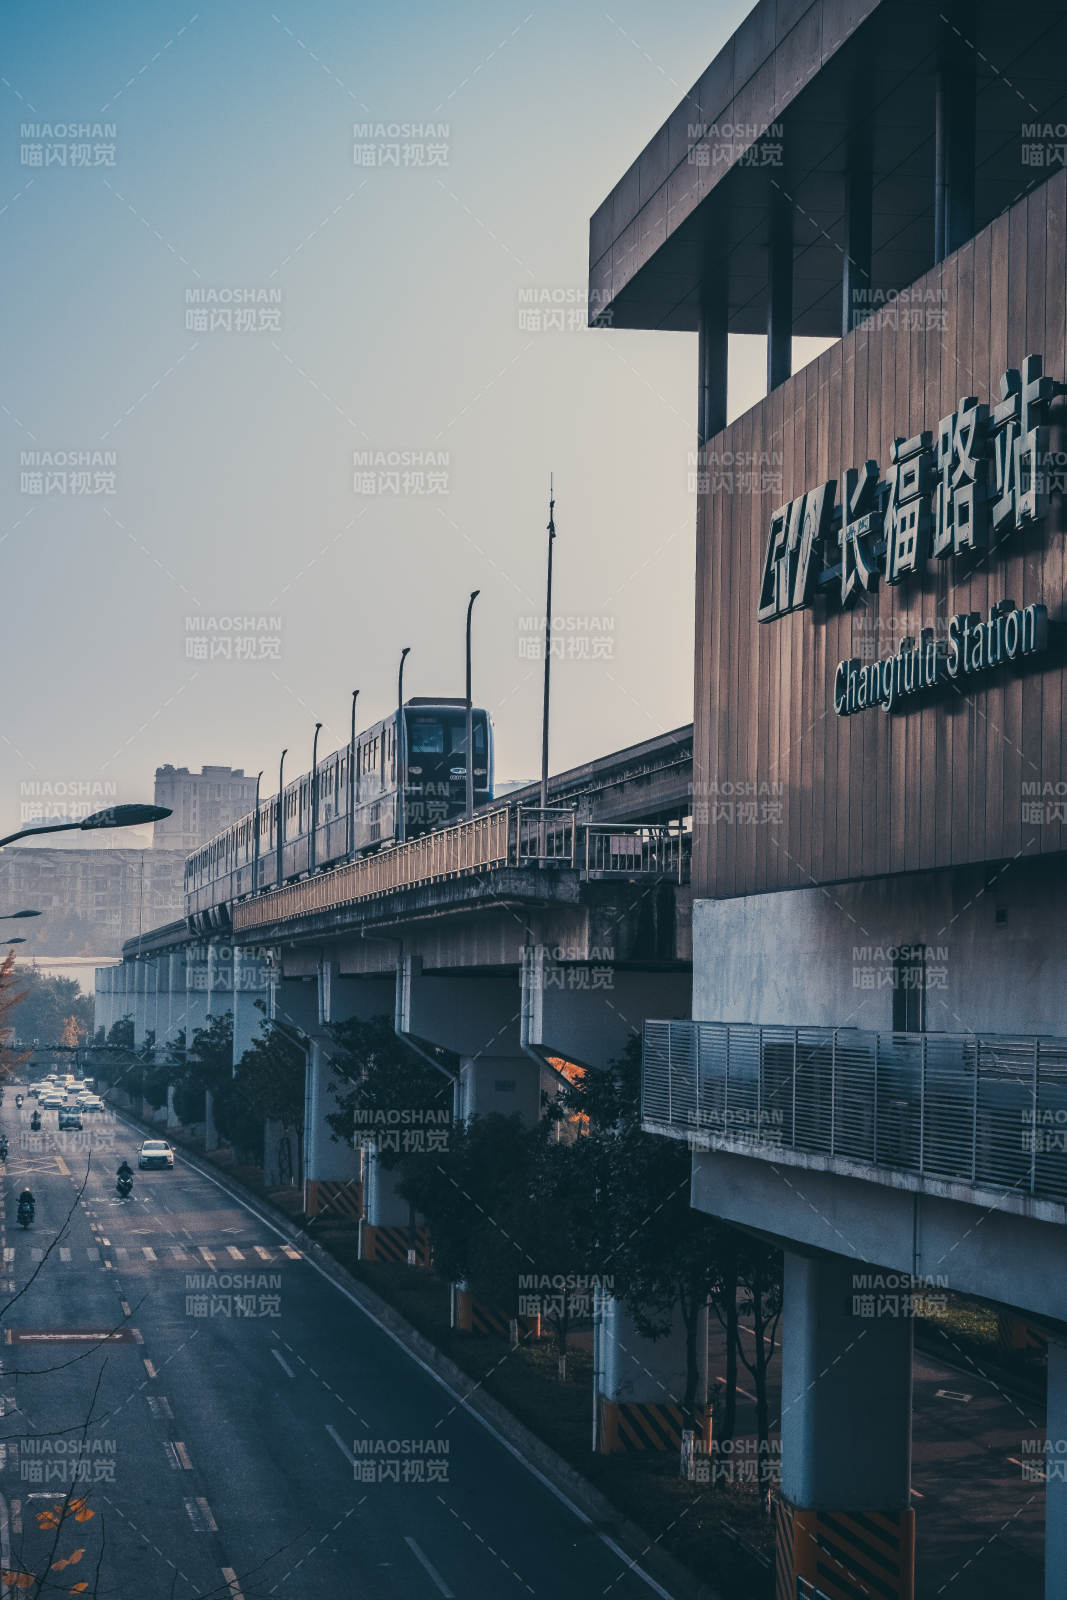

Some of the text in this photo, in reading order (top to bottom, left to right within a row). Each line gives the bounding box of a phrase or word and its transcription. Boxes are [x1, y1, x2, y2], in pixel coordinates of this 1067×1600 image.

[837, 354, 1049, 606] 长福路站
[946, 602, 1041, 679] Station
